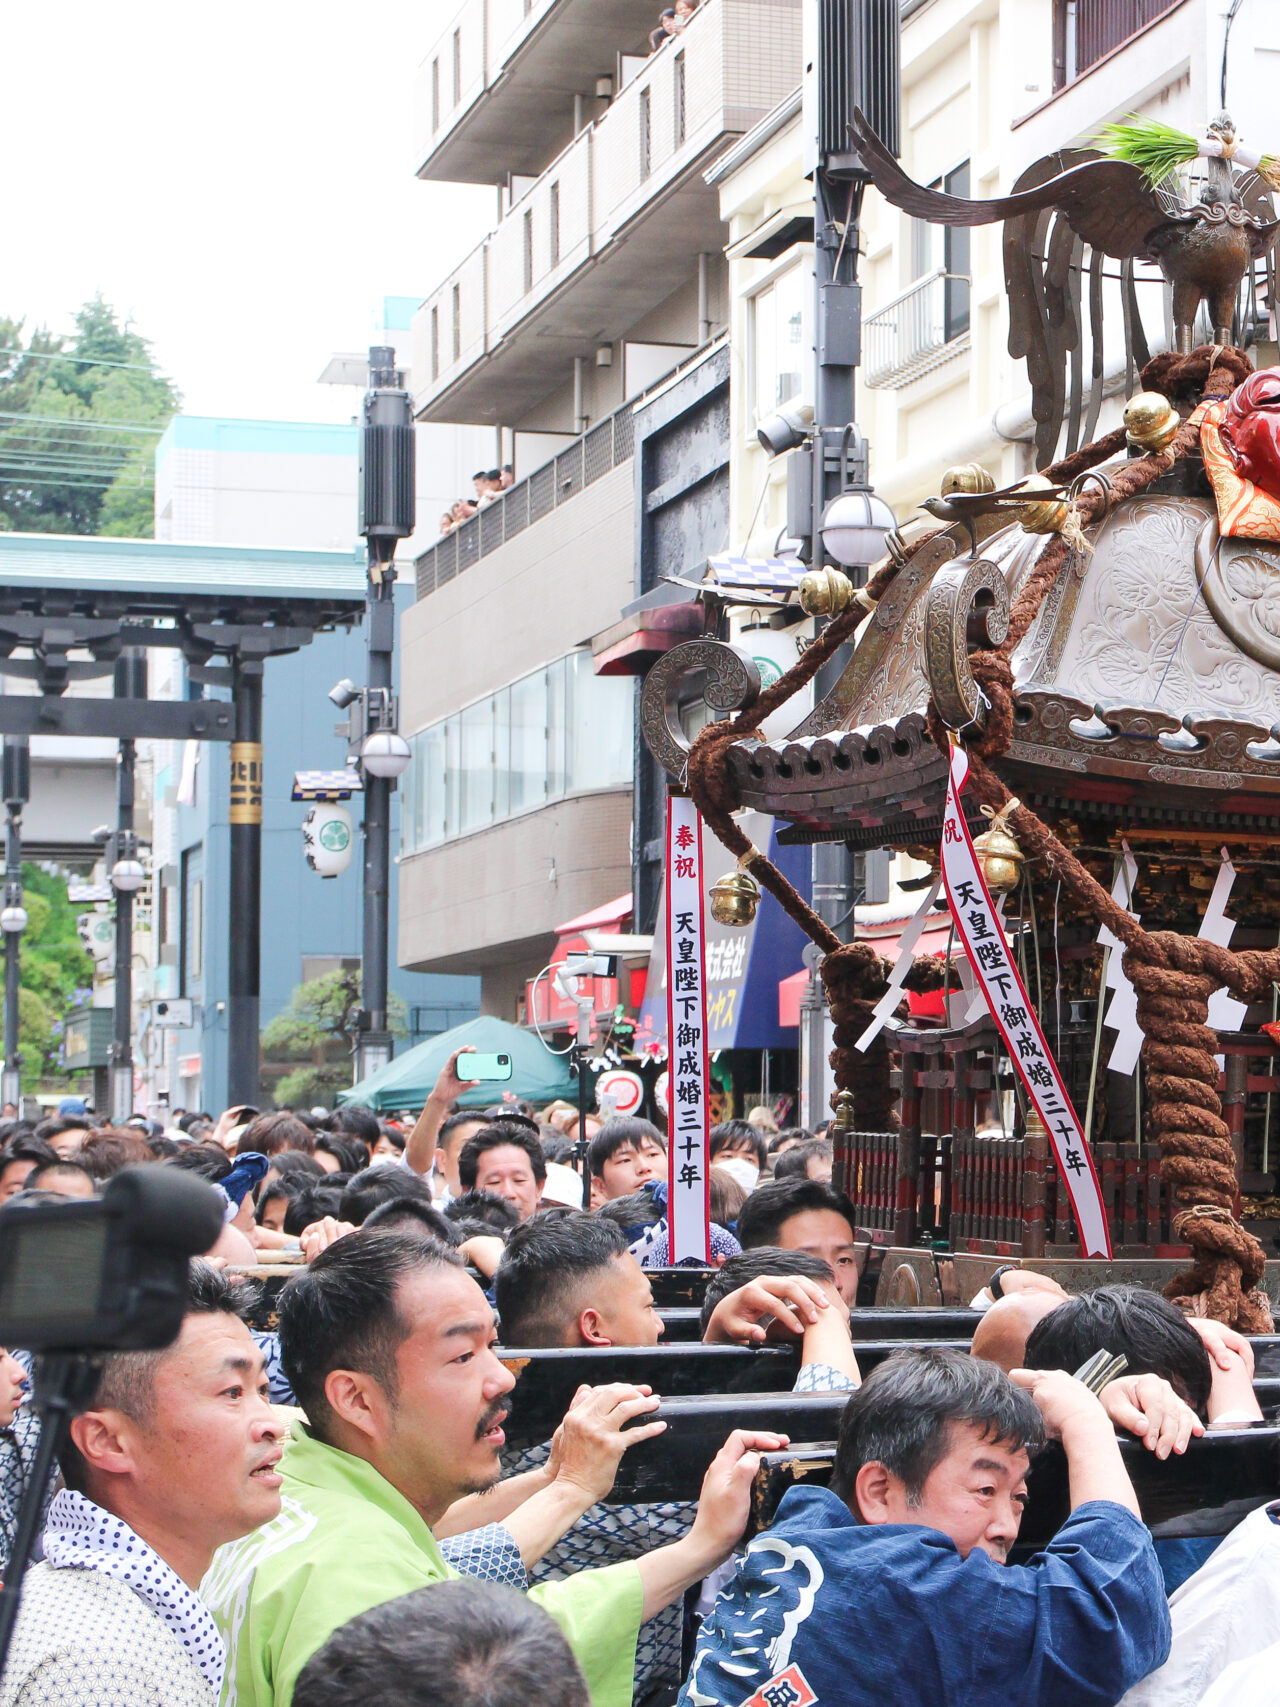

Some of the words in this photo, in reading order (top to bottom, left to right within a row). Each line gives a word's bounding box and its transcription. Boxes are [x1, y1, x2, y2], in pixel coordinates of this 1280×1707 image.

[675, 825, 696, 878] 奉祝
[675, 912, 702, 1189] 天皇陛下御成婚三十年
[953, 880, 1087, 1177] 天皇陛下御成婚三十年
